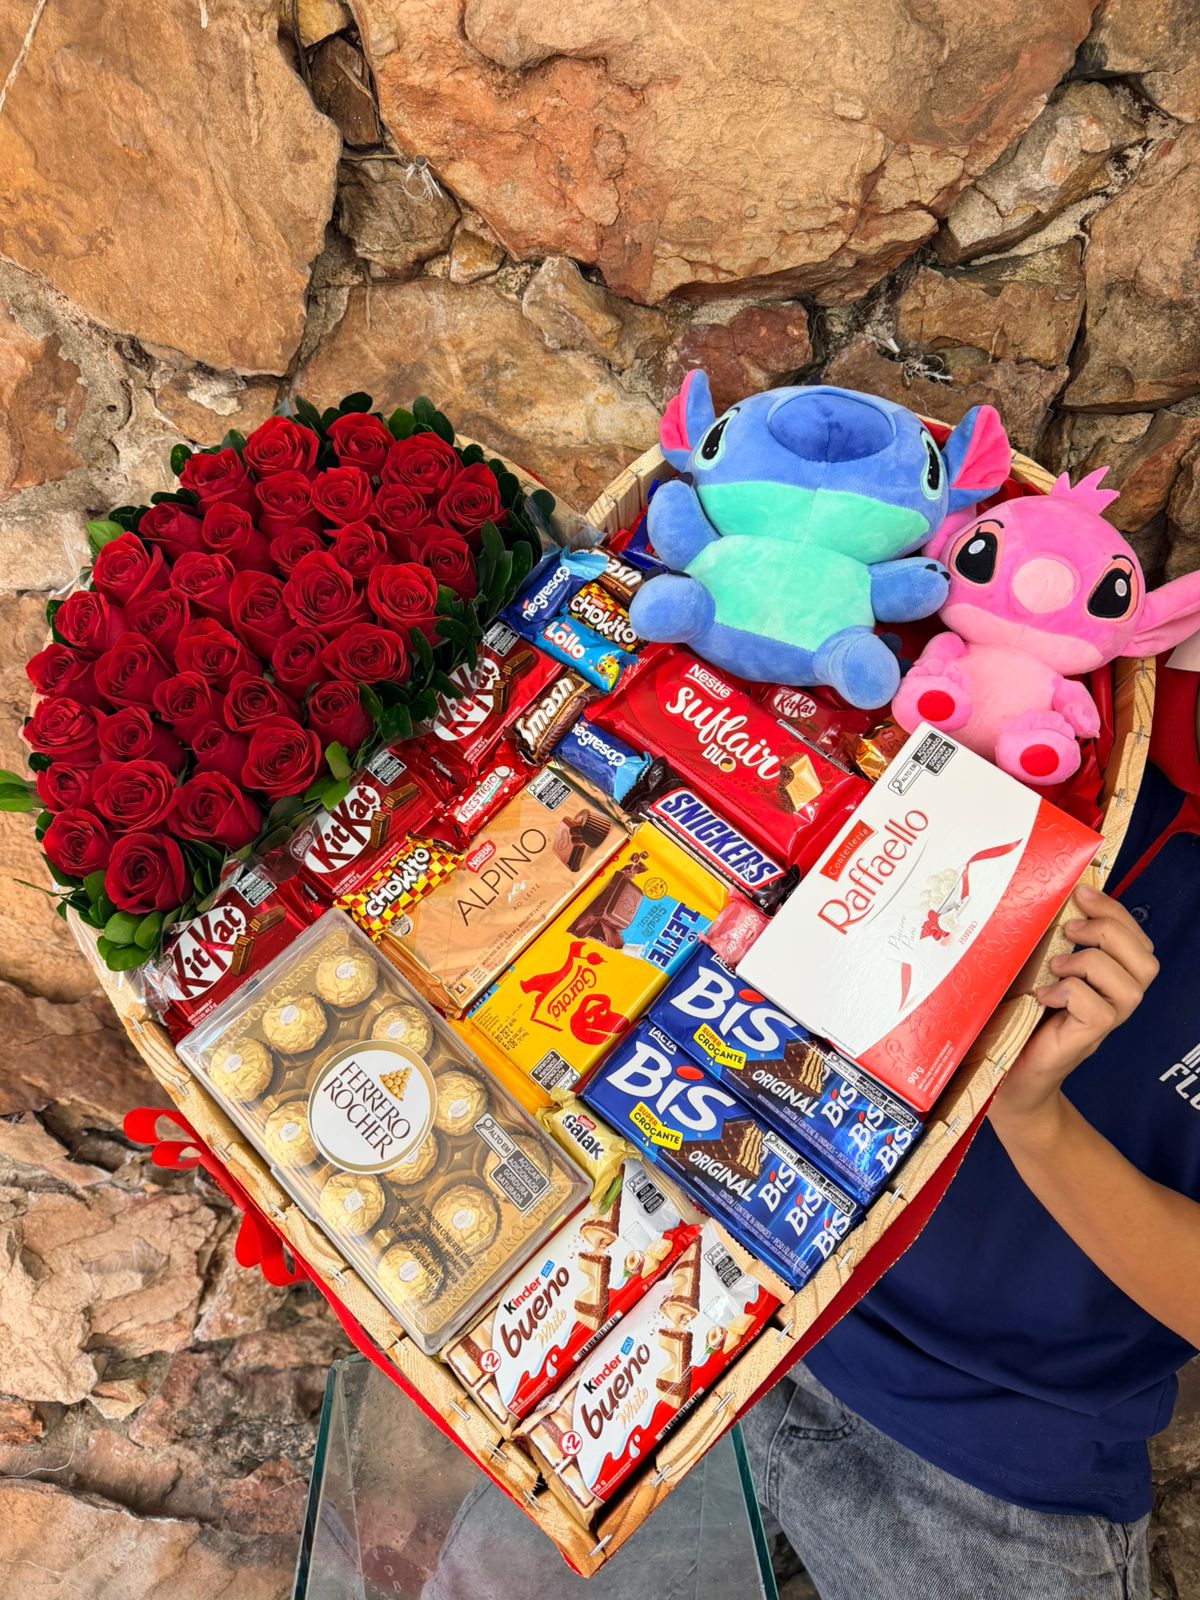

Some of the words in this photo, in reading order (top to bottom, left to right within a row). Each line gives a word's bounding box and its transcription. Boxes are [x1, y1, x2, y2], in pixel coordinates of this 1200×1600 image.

[522, 566, 570, 622] negresco
[685, 664, 733, 700] Nestlé
[515, 677, 575, 751] Smash
[775, 693, 817, 718] KitKat
[666, 687, 781, 780] Suflair
[460, 774, 499, 819] PRESTIGIO
[900, 769, 912, 783] ALTO
[308, 786, 377, 872] KitKat
[660, 793, 779, 884] SNICKERS
[457, 828, 546, 926] ALPINO
[468, 843, 494, 870] Nestlé
[817, 809, 929, 935] Raffaello
[522, 882, 540, 900] LEITE
[171, 907, 243, 998] KitKat
[647, 903, 700, 969] LEITE
[552, 966, 597, 1019] Garoto
[649, 1026, 678, 1055] LACTA
[697, 1033, 744, 1065] CROCANTE
[701, 1026, 722, 1048] SUPER
[752, 1069, 821, 1119] ORIGINAL
[906, 1071, 919, 1085] 90
[323, 1077, 393, 1160] ROCHER
[339, 1061, 411, 1140] FERRERO
[638, 1105, 659, 1127] SUPER
[488, 1128, 503, 1145] ALTO
[500, 1142, 511, 1153] EM
[562, 1114, 605, 1160] Galak
[633, 1112, 680, 1144] CROCANTE
[495, 1173, 524, 1204] SATURADA
[501, 1168, 529, 1198] GORDURA
[507, 1157, 539, 1192] ADICIONADO
[688, 1150, 758, 1202] ORIGINAL
[500, 1266, 570, 1358] bueno
[503, 1277, 542, 1315] Kinder
[534, 1308, 567, 1348] White
[581, 1344, 651, 1439] bueno
[583, 1354, 622, 1395] Kinder
[616, 1386, 649, 1430] White
